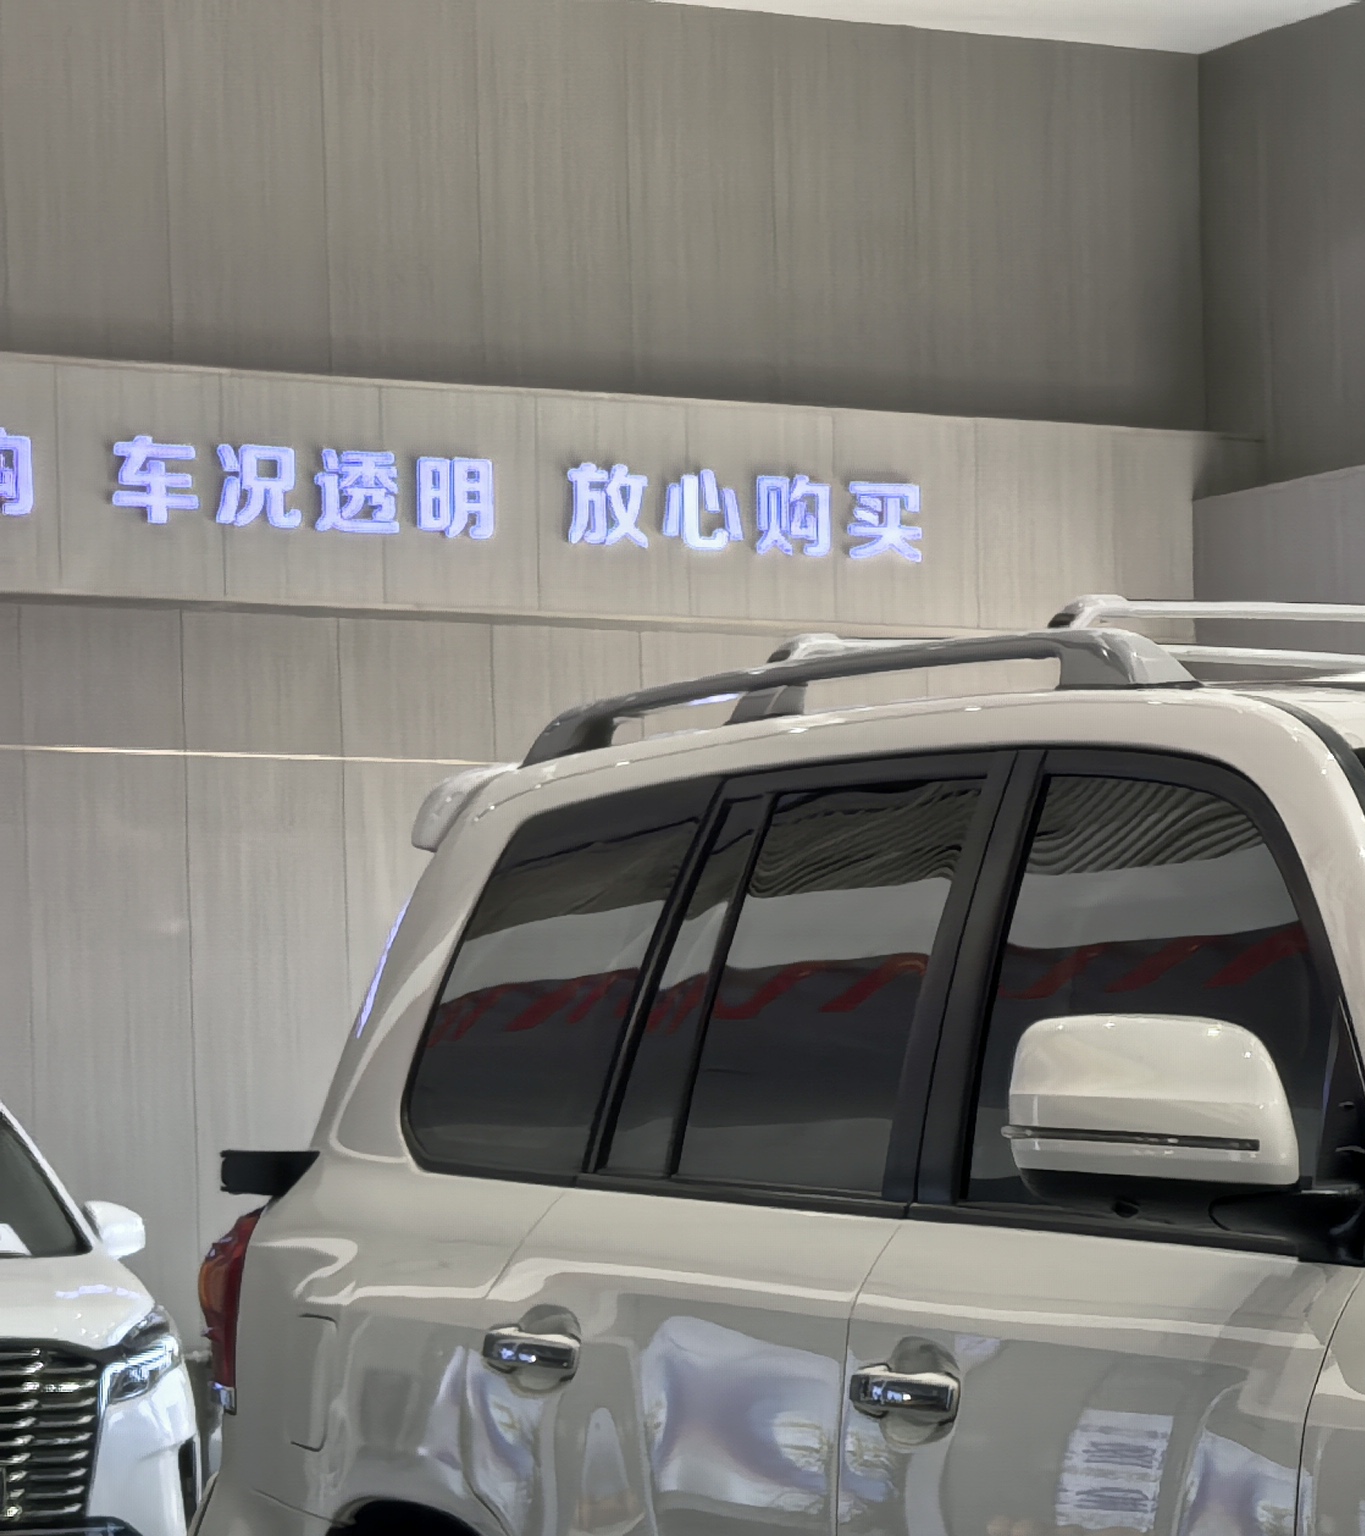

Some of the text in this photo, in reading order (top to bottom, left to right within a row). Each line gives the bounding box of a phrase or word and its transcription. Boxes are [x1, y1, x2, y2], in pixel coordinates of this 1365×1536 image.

[111, 435, 494, 540] 车况透明
[566, 462, 923, 562] 放心购买
